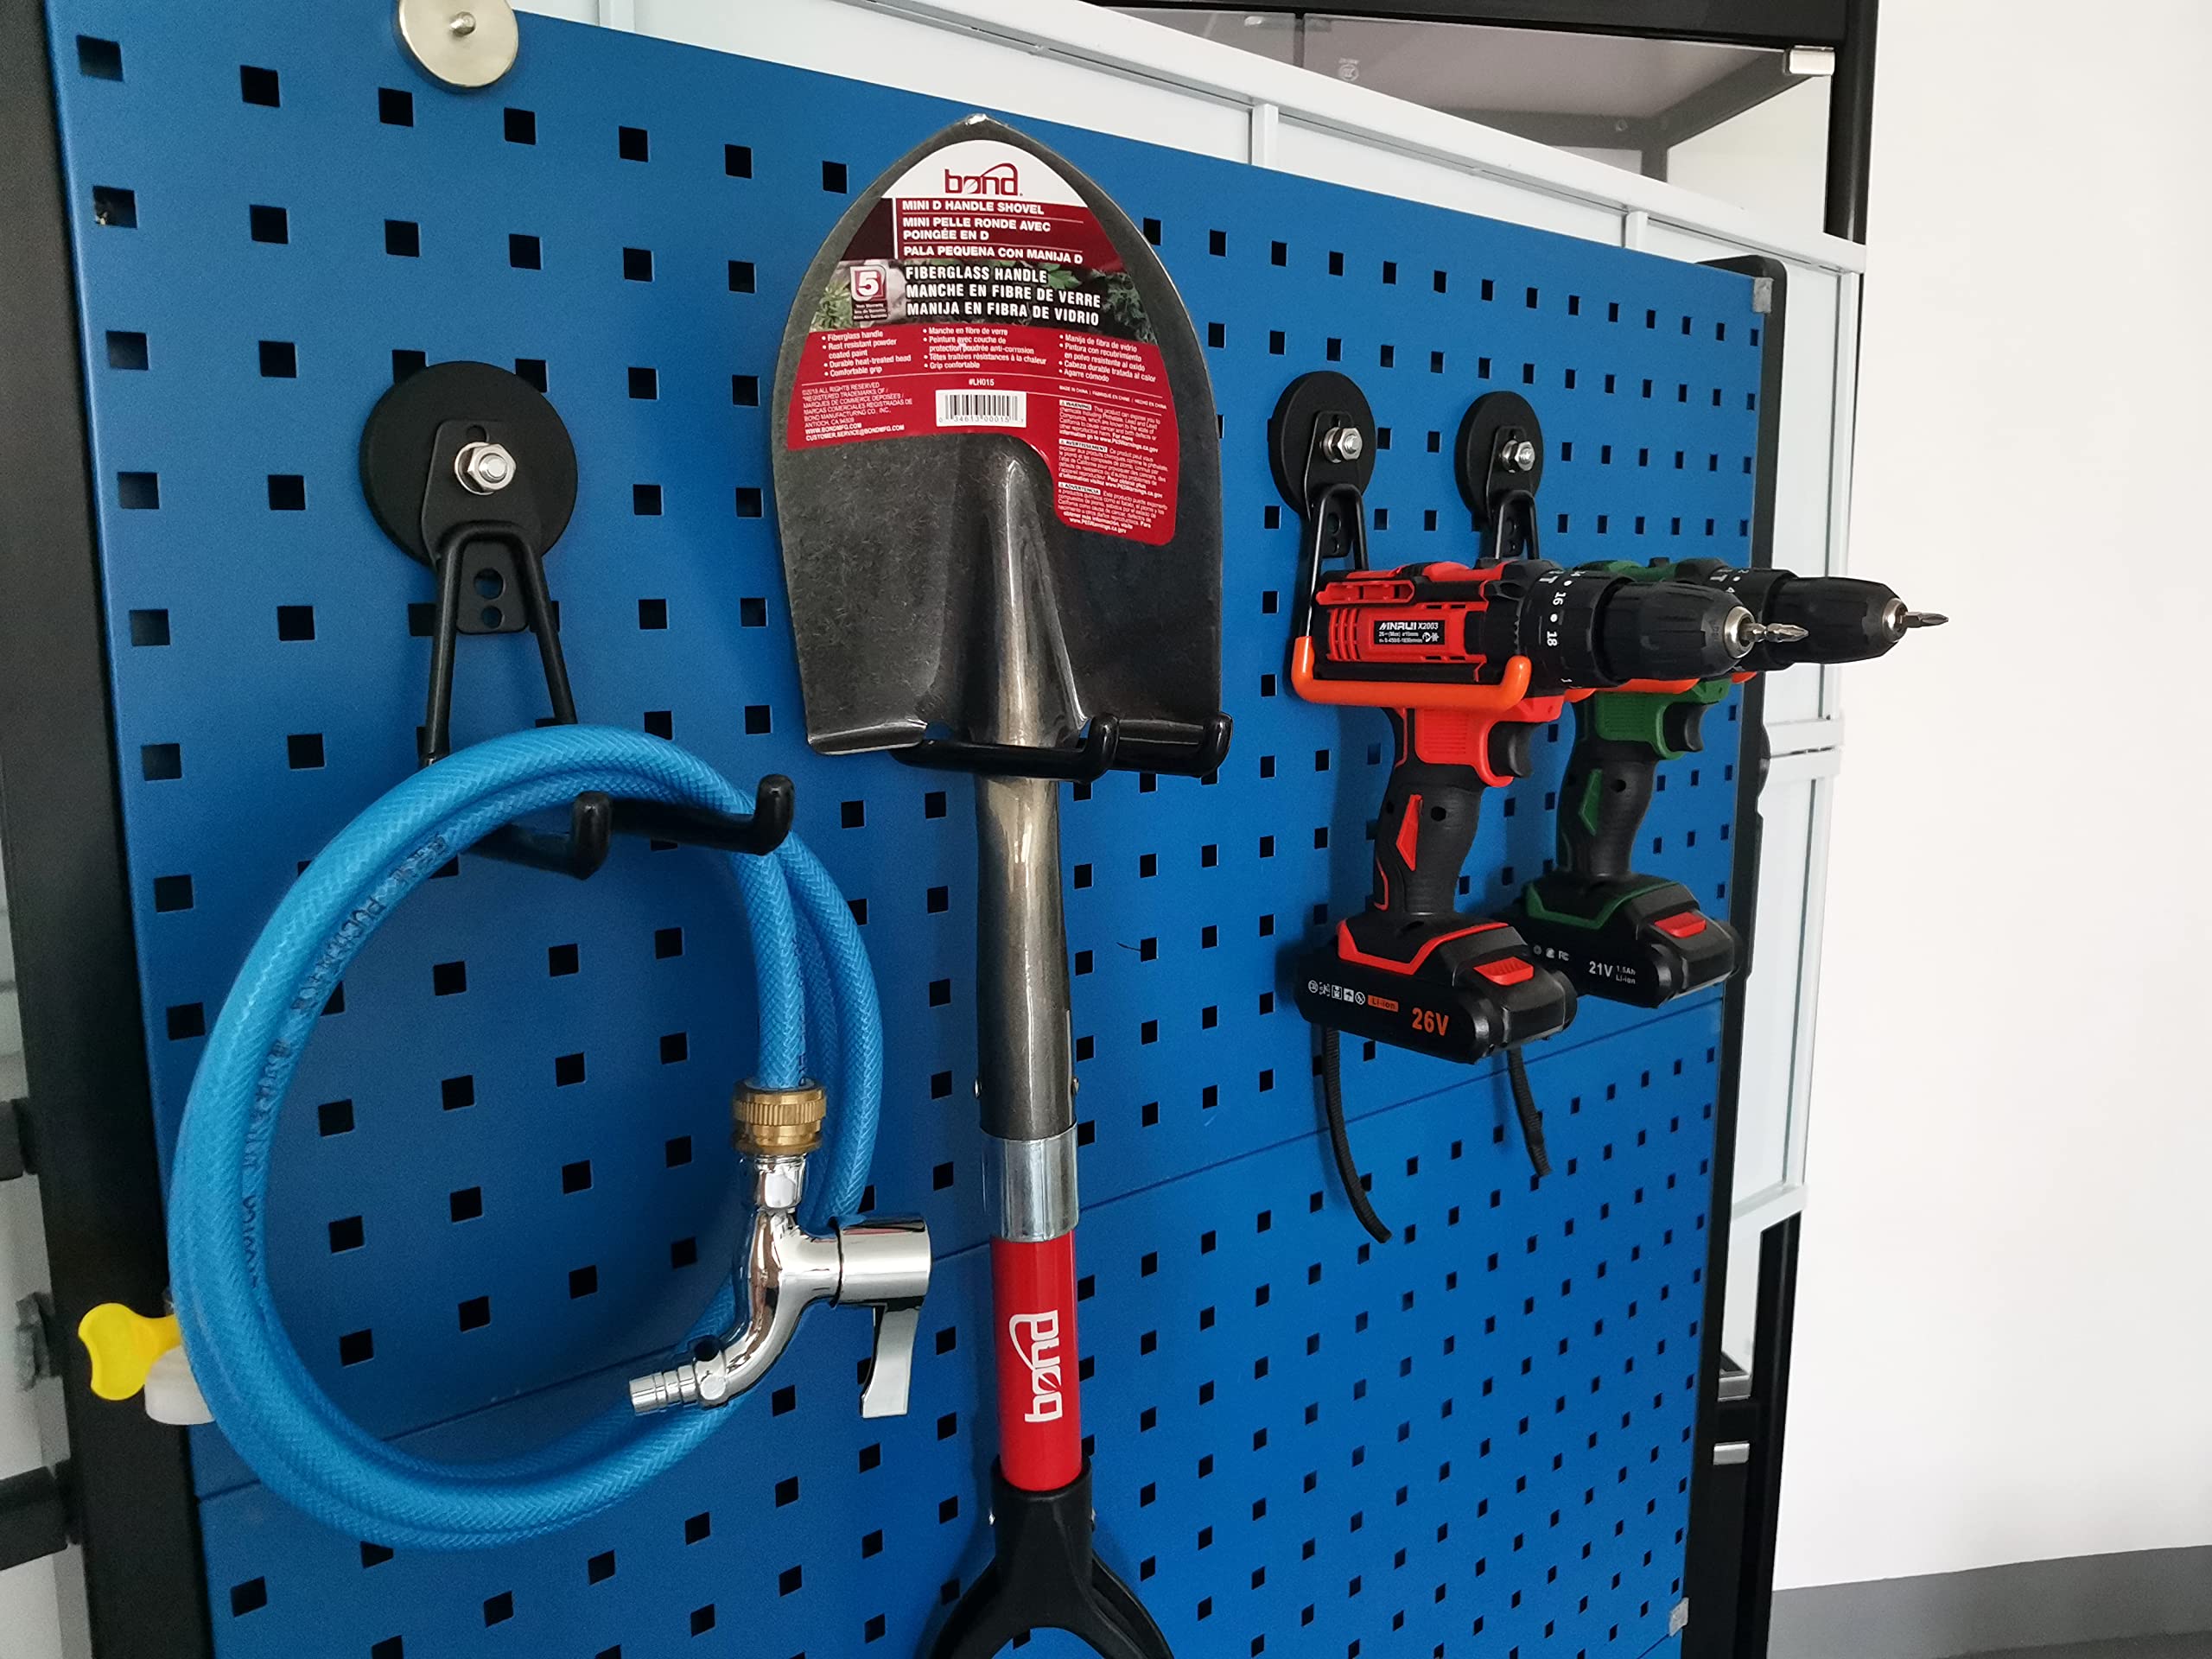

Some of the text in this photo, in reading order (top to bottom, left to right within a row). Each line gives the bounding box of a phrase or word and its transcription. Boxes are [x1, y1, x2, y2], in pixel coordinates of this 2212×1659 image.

[944, 162, 1019, 197] bond
[902, 200, 1044, 215] MINI D HANDLE SHOVEL
[902, 217, 1051, 232] MINI PELLE RONDE AVEC
[903, 226, 989, 241] POINGÉE EN D
[904, 245, 1084, 264] PALA PEQUENA CON MANIJA D
[906, 265, 1047, 284] FIBERGLASS HANDLE
[858, 271, 880, 296] 5
[906, 283, 1101, 308] MANCHE EN FIBRE DE VERRE
[907, 302, 1099, 327] MANIJA EN FIBRA DE VIDRIO
[827, 330, 883, 342] Fiberglass handle
[928, 327, 954, 335] Manche
[844, 340, 872, 350] resistant
[873, 339, 897, 348] powder
[1065, 334, 1137, 353] Manija de fibra de vidrio
[1065, 342, 1087, 353] Pintura
[829, 349, 868, 359] coated paint
[1023, 355, 1046, 365] chaleur
[1073, 353, 1090, 362] polvo
[1122, 360, 1128, 369] al
[830, 359, 854, 368] Durable
[855, 356, 894, 365] heat-treated
[930, 361, 943, 371] Grip
[830, 366, 882, 378] Comfortable grip
[1064, 359, 1087, 370] Cabeza
[1087, 363, 1110, 374] durable
[1111, 367, 1133, 378] tratada
[1141, 373, 1156, 383] calor
[1064, 368, 1084, 379] Agarre
[1552, 591, 1567, 607] 16
[1418, 622, 1440, 631] X2003
[1546, 630, 1559, 647] 18
[1588, 959, 1614, 978] 21V
[1411, 1007, 1450, 1037] 26V
[1009, 1309, 1064, 1423] bond
